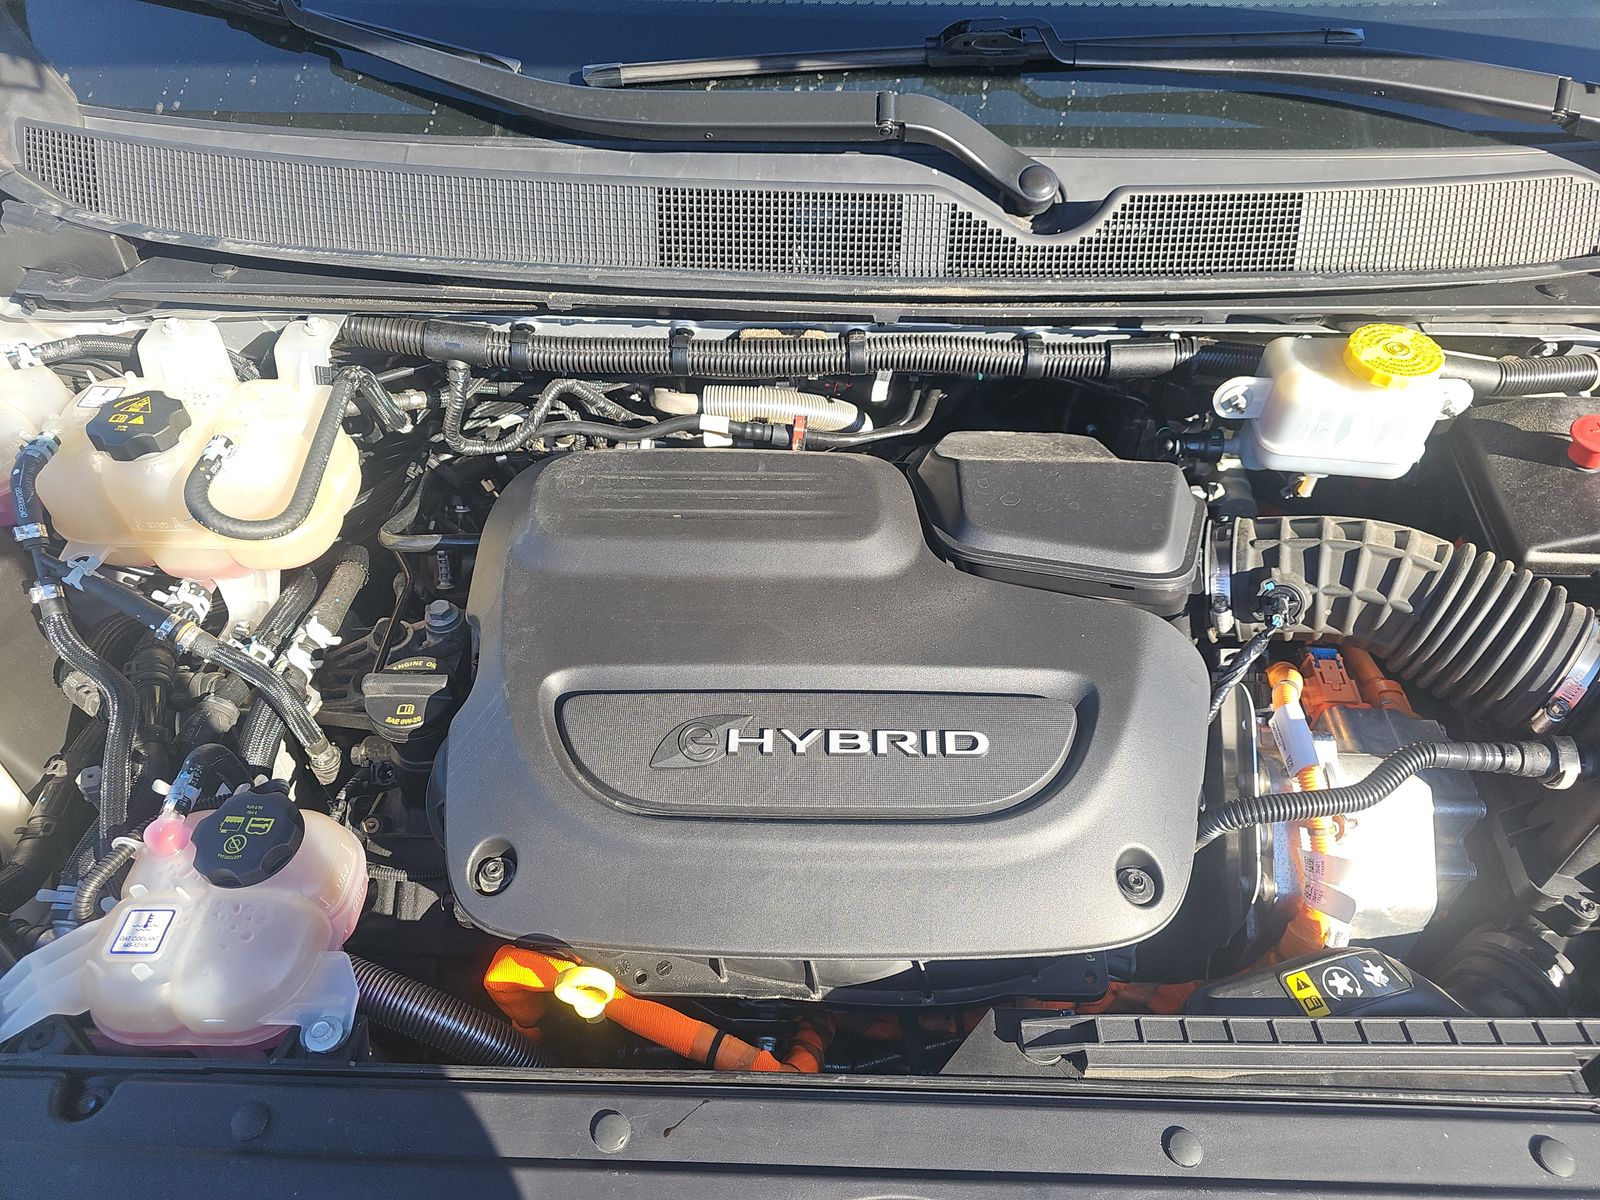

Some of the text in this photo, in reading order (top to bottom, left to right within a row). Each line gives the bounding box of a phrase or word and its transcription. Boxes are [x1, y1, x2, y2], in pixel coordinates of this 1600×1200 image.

[393, 660, 437, 671] ENGINE OIL
[385, 716, 422, 725] SAE 0W-20
